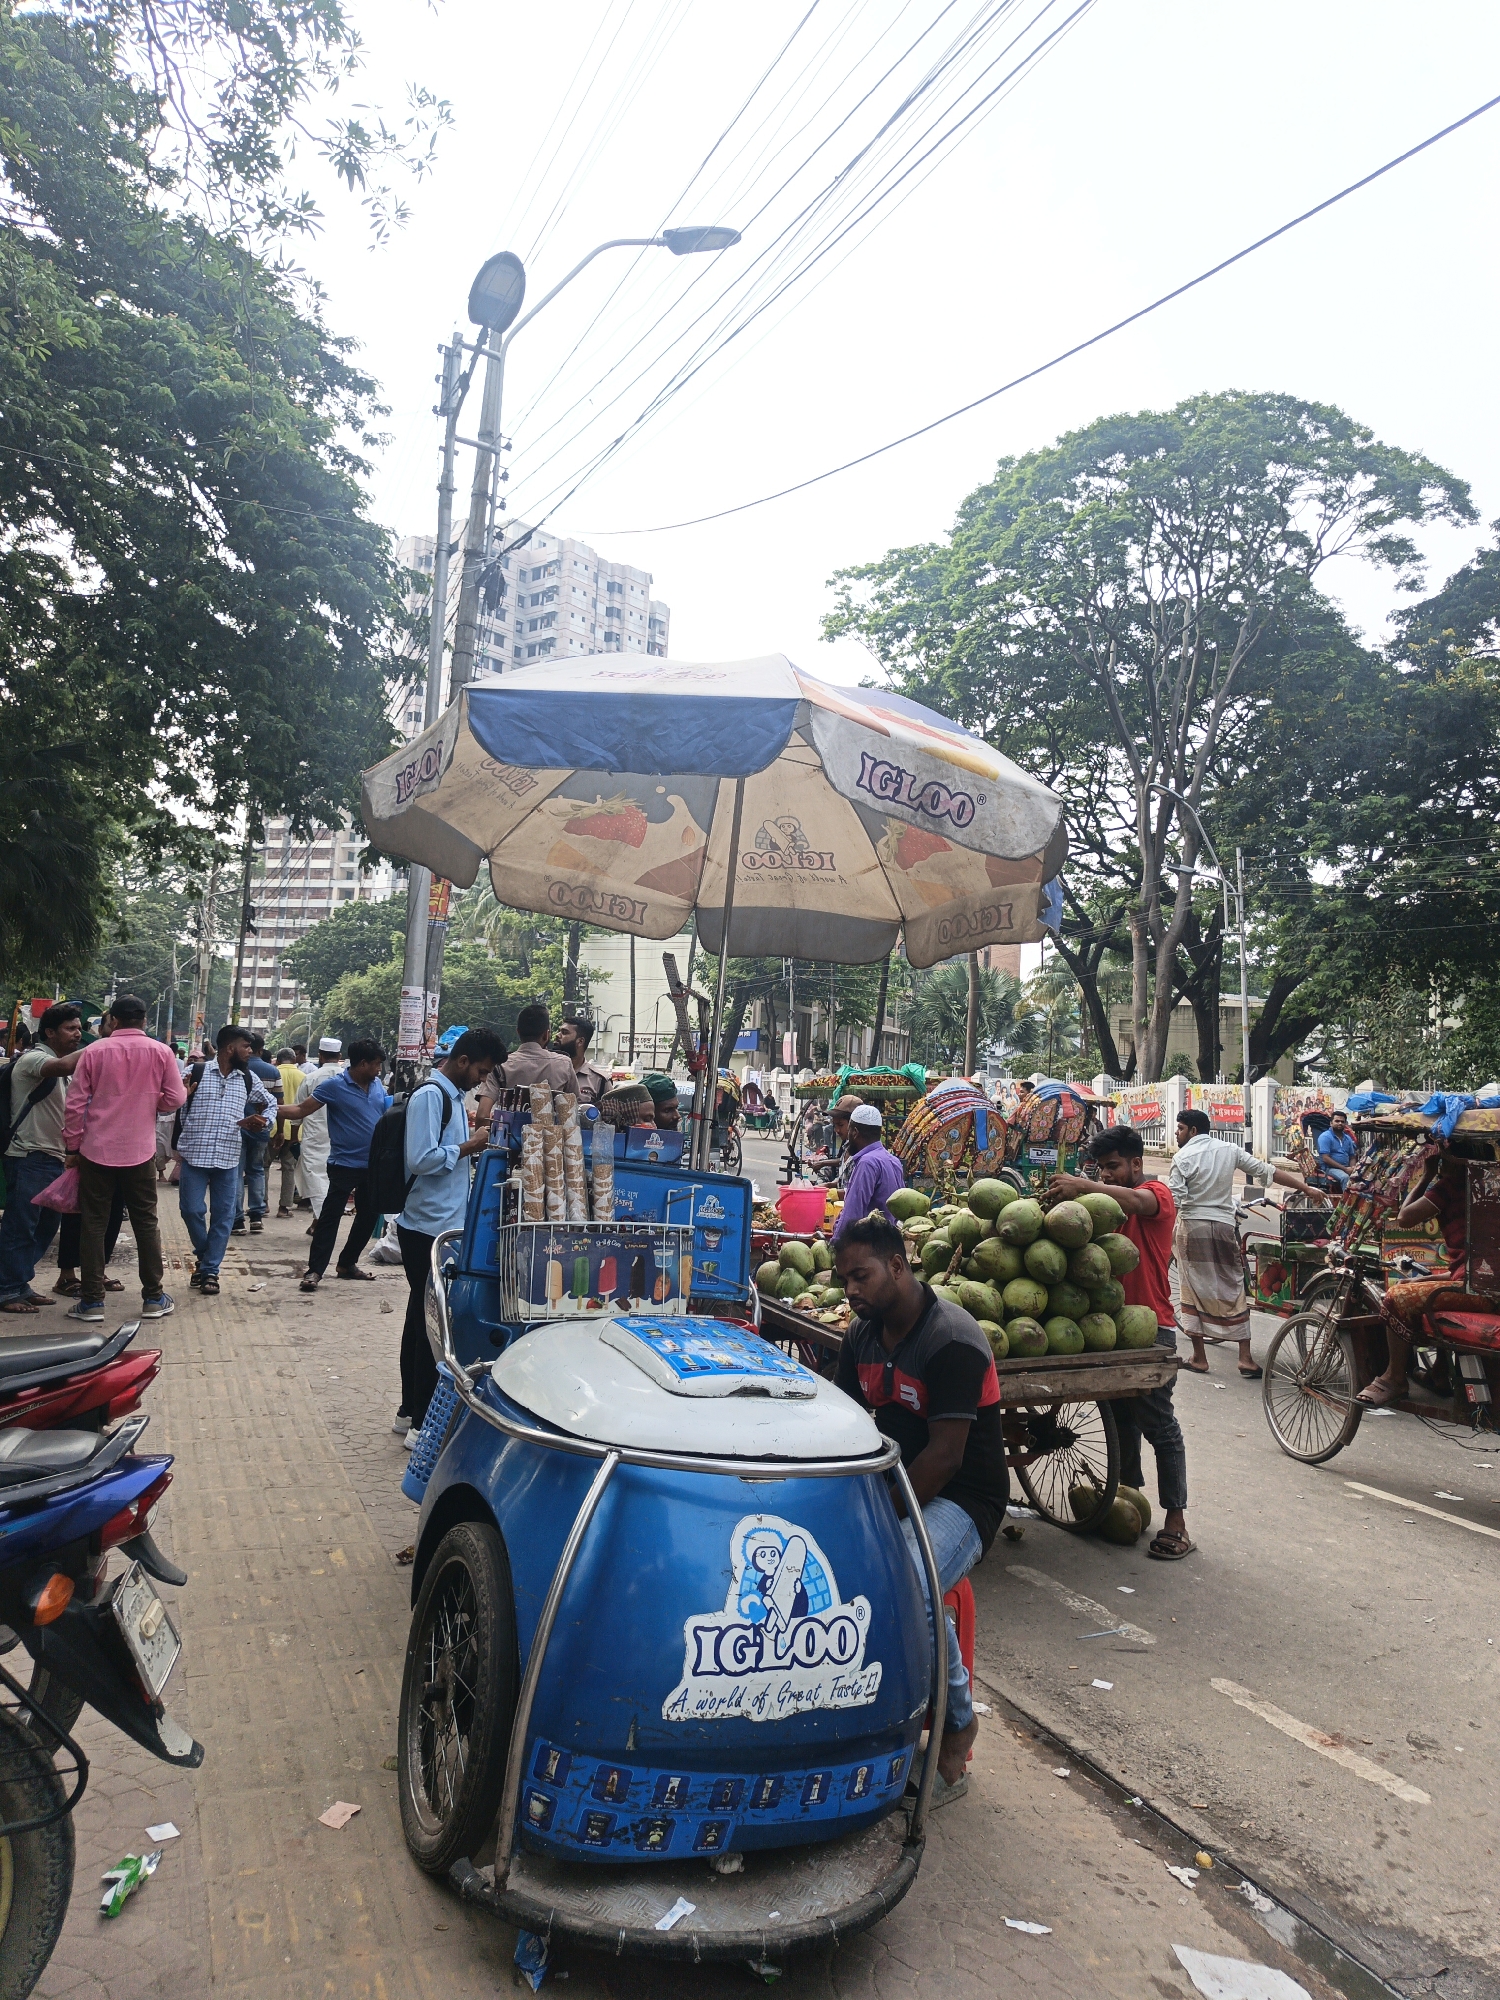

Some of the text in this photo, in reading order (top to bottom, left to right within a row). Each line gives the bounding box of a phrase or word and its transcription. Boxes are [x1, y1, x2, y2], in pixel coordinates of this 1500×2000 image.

[856, 751, 976, 828] IGLOO
[692, 1616, 860, 1677] IGLOO
[671, 1689, 689, 1713] A
[696, 1683, 747, 1711] world
[752, 1683, 773, 1715] of
[777, 1680, 823, 1712] Great
